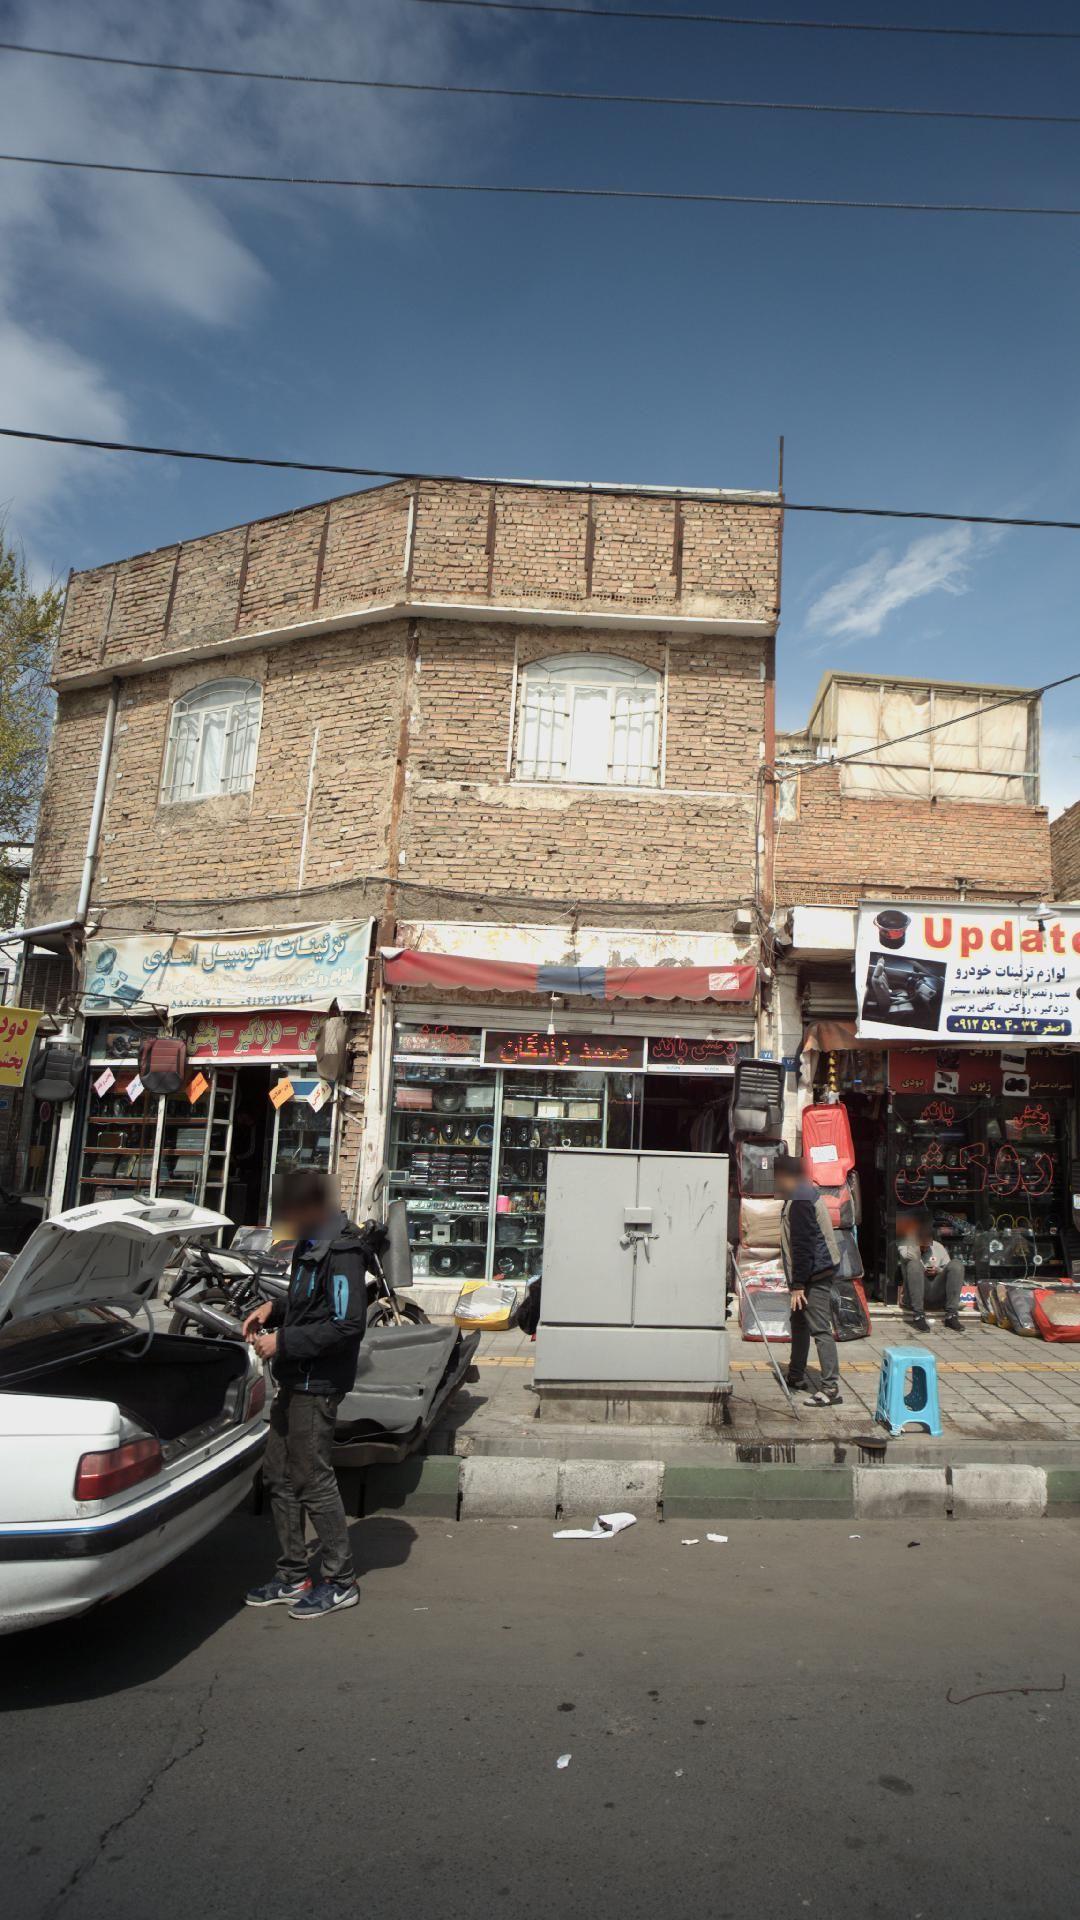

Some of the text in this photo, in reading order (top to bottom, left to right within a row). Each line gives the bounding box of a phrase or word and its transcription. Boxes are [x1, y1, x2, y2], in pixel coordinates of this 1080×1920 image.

[275, 932, 349, 964] تزئینات
[202, 938, 272, 973] اتومبیل
[955, 965, 1066, 983] لوازم تزئینات خودرو
[977, 986, 990, 996] باند
[996, 986, 1012, 996] ضبط
[1013, 987, 1031, 998] انواع
[977, 1002, 996, 1013] کفی
[1004, 1003, 1032, 1014] روکش
[1040, 1003, 1069, 1015] دزدگیر
[953, 1018, 980, 1030] ۰۹۱۲
[1041, 1021, 1065, 1035] اصغر
[187, 1018, 220, 1056] پخش
[234, 1016, 282, 1053] دزدگیر
[652, 1037, 738, 1066] پخش باند
[901, 1077, 925, 1088] دودی
[1014, 1103, 1050, 1134] پخش
[895, 1142, 1054, 1205] روکش
